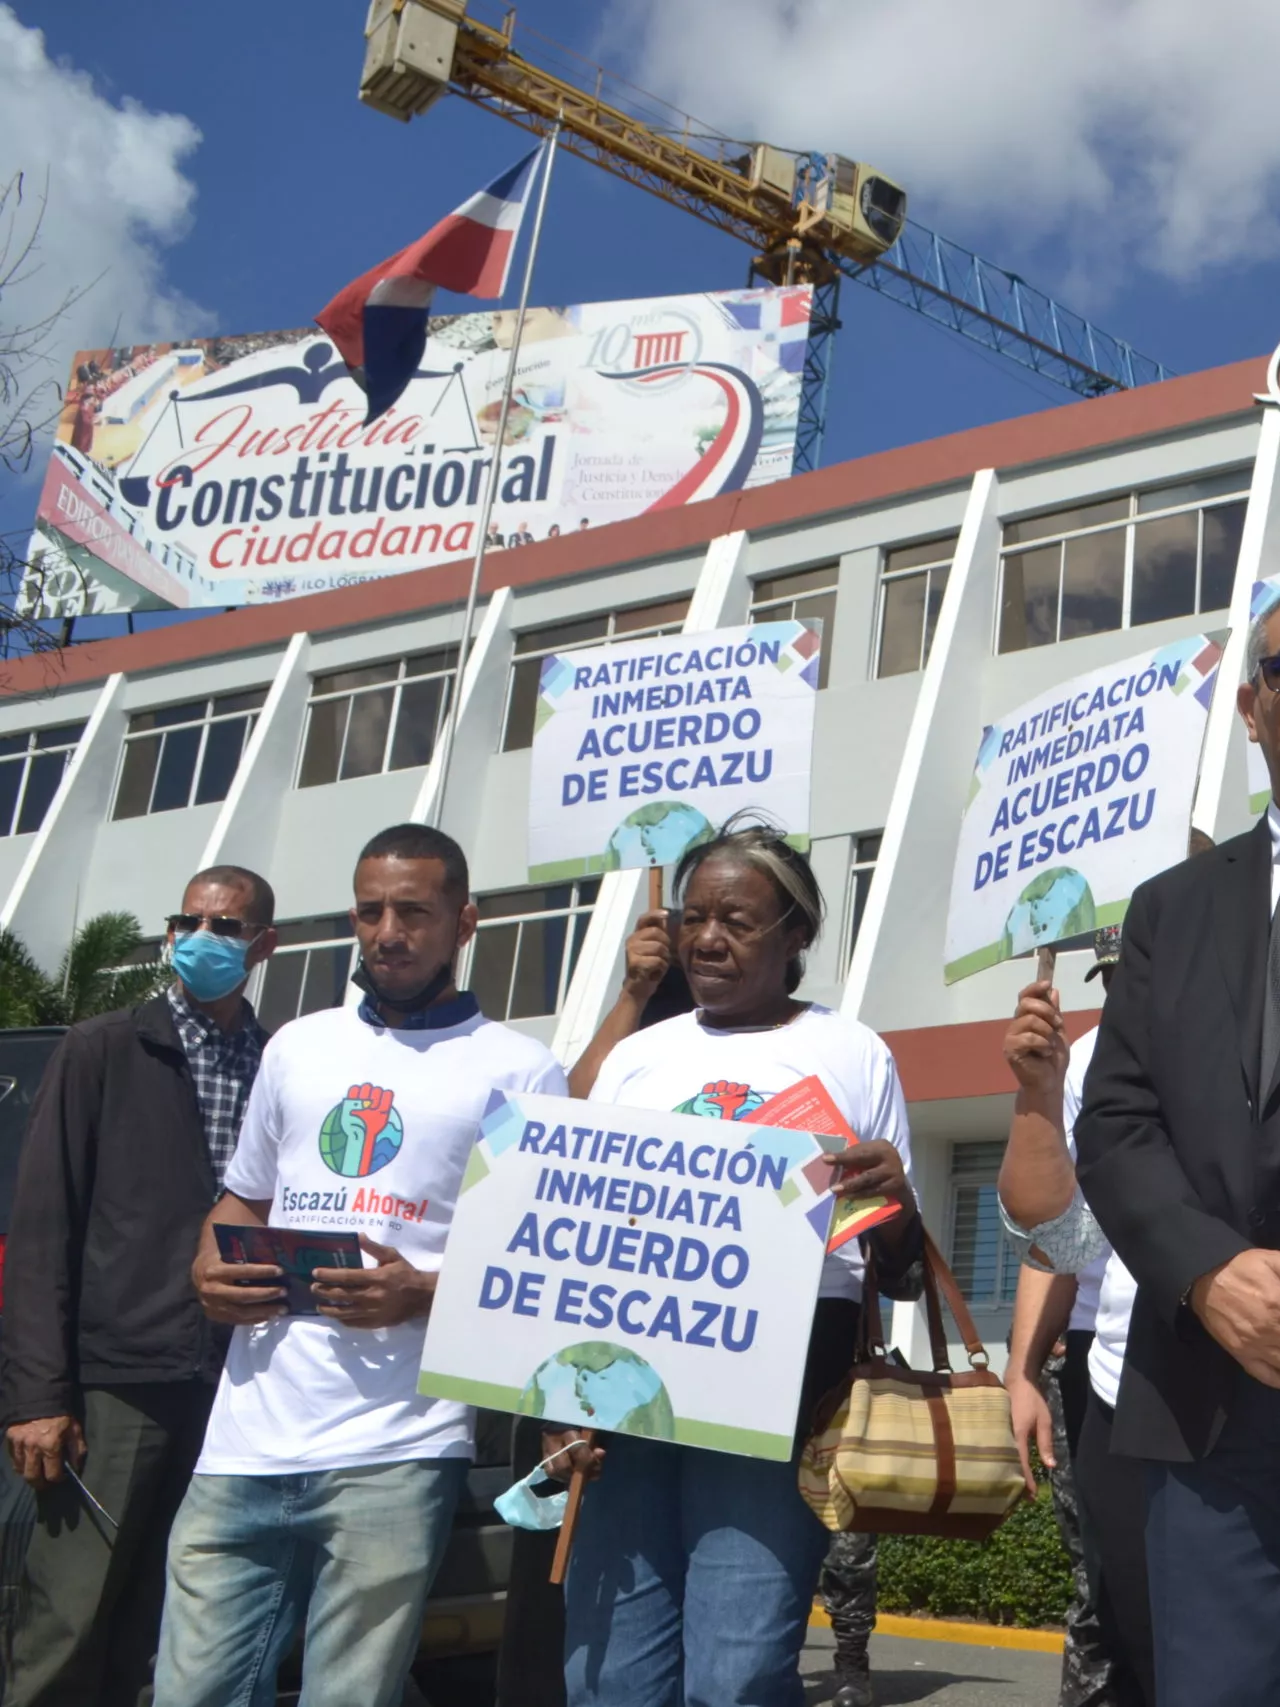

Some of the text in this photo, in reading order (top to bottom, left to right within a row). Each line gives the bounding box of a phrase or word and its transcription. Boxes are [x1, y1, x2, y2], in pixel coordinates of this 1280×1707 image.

[155, 398, 424, 487] Justicia
[641, 468, 684, 483] Derech
[155, 435, 557, 531] Constitucional
[209, 516, 475, 569] Ciudadana
[574, 638, 780, 690] RATIFICACIÓN
[592, 676, 752, 719] INMEDIATA
[576, 708, 762, 761] ACUERDO
[998, 660, 1181, 757] RATIFICACIÓN
[562, 749, 773, 806] DE ESCAZU
[1006, 707, 1144, 786] INMEDIATA
[989, 743, 1150, 837] ACUERDO
[974, 788, 1156, 891] DE ESCAZU
[519, 1120, 788, 1190] RATIFICACIÓN
[282, 1186, 429, 1223] Escazú Ahora!
[368, 1217, 383, 1228] EN
[535, 1168, 742, 1232] INMEDIATA
[506, 1212, 750, 1289] ACUERDO
[478, 1266, 759, 1352] DE ESCAZU
